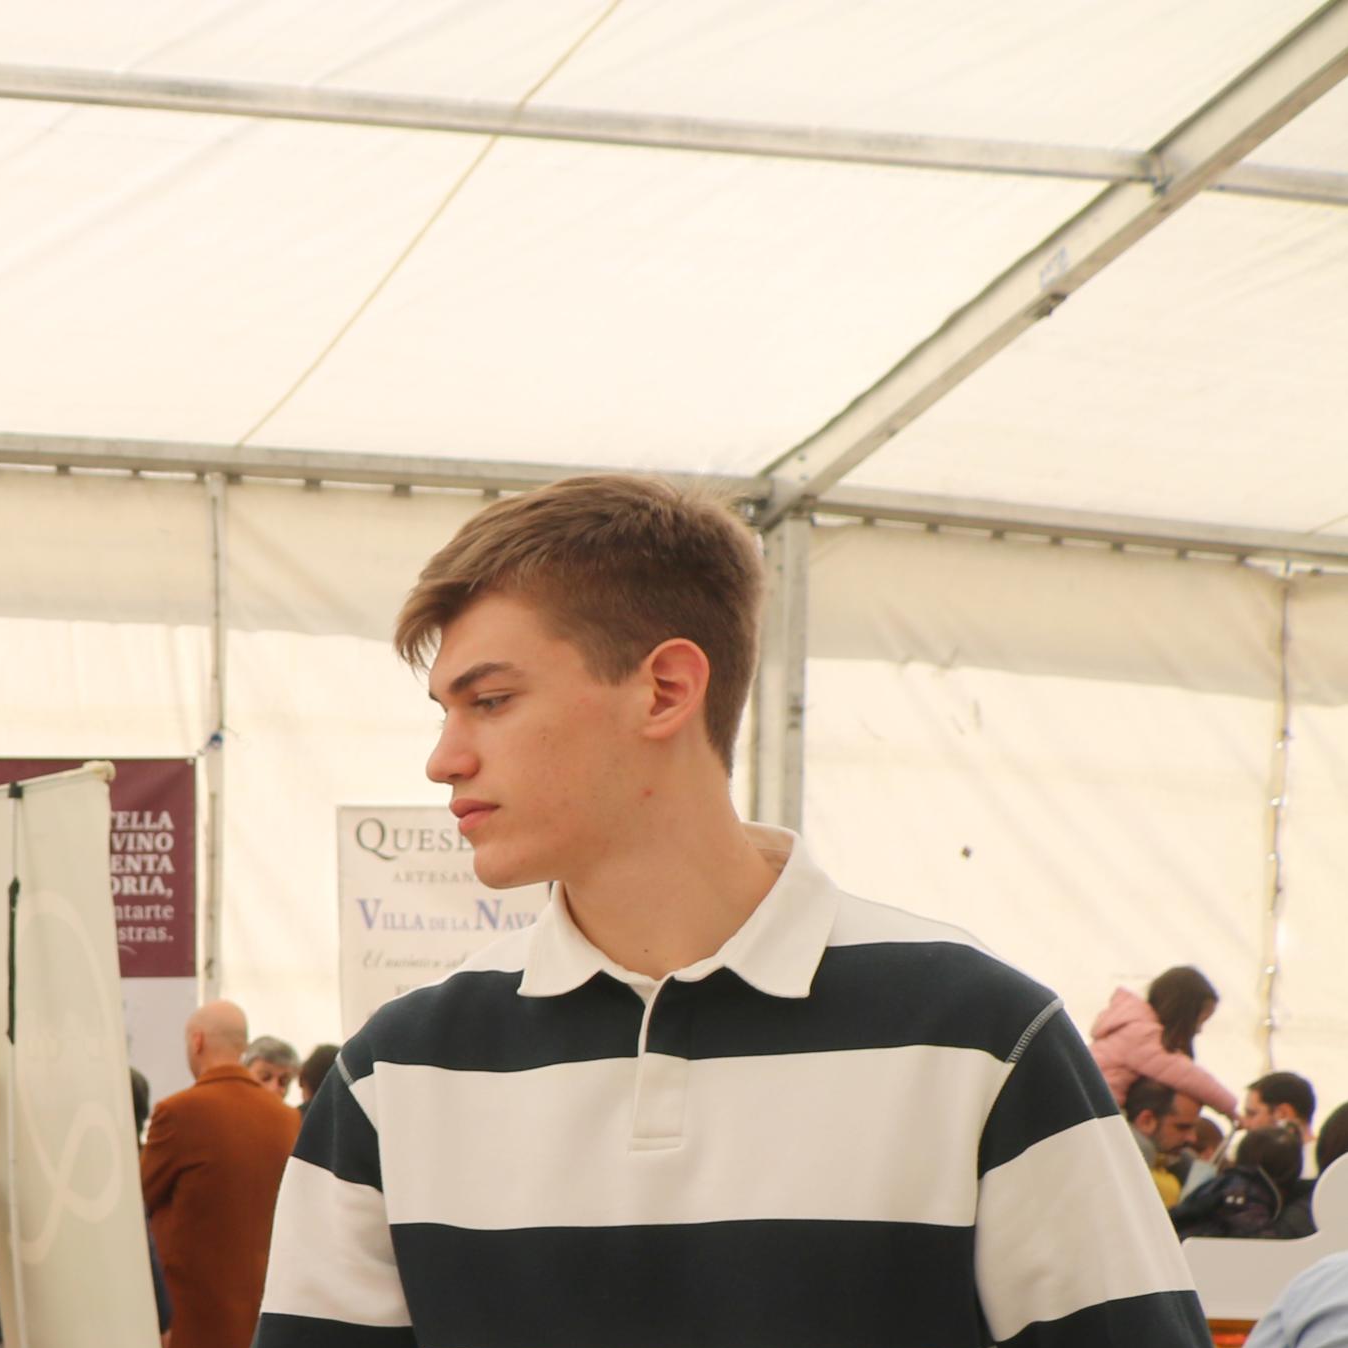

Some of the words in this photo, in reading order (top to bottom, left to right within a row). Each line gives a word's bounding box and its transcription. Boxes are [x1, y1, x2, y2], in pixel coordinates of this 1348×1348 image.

[111, 831, 175, 852] VINO
[356, 898, 424, 931] VILLA
[429, 913, 450, 931] DE
[451, 913, 470, 931] LA
